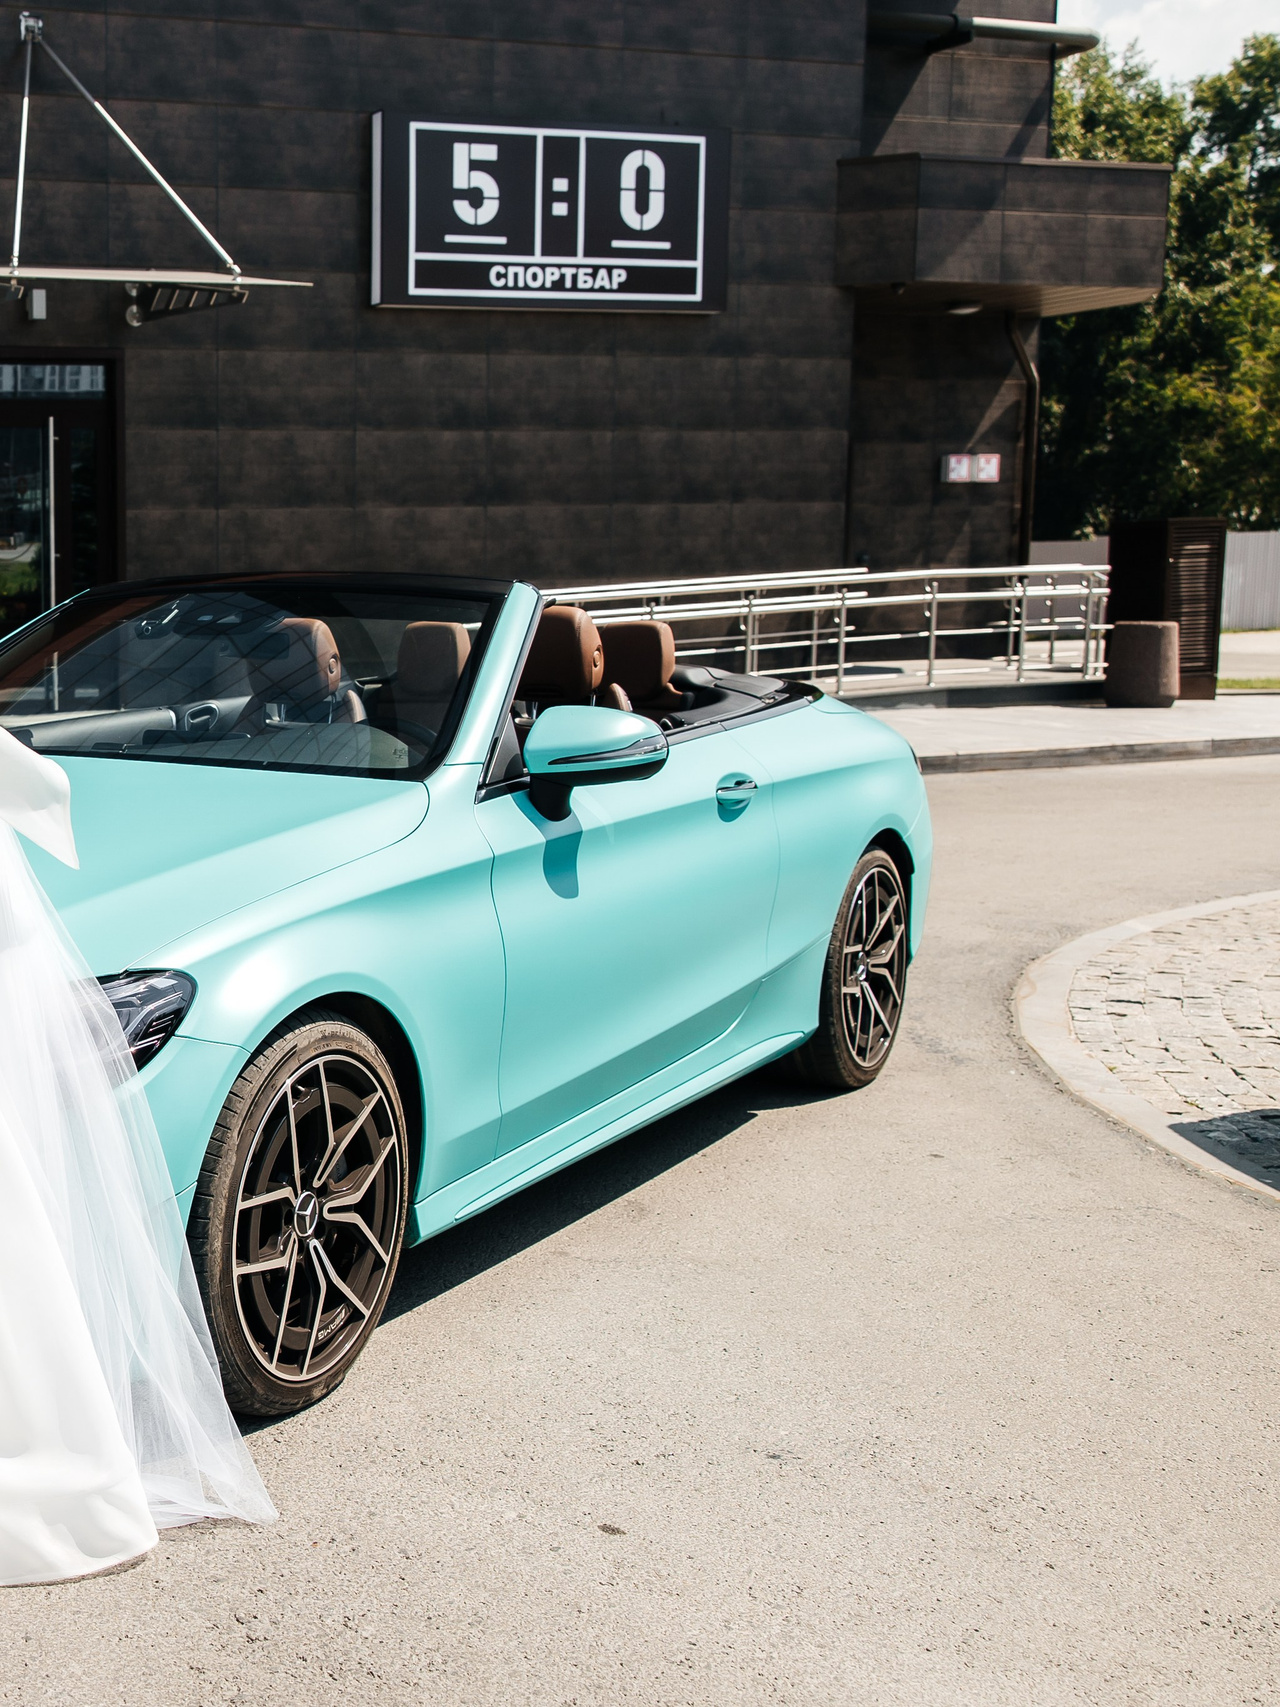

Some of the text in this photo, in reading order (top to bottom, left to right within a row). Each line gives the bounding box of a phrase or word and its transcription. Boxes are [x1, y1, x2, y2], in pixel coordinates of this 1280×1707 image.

[453, 142, 500, 225] 5
[620, 149, 665, 231] 0
[489, 265, 627, 290] СПОРТБАР
